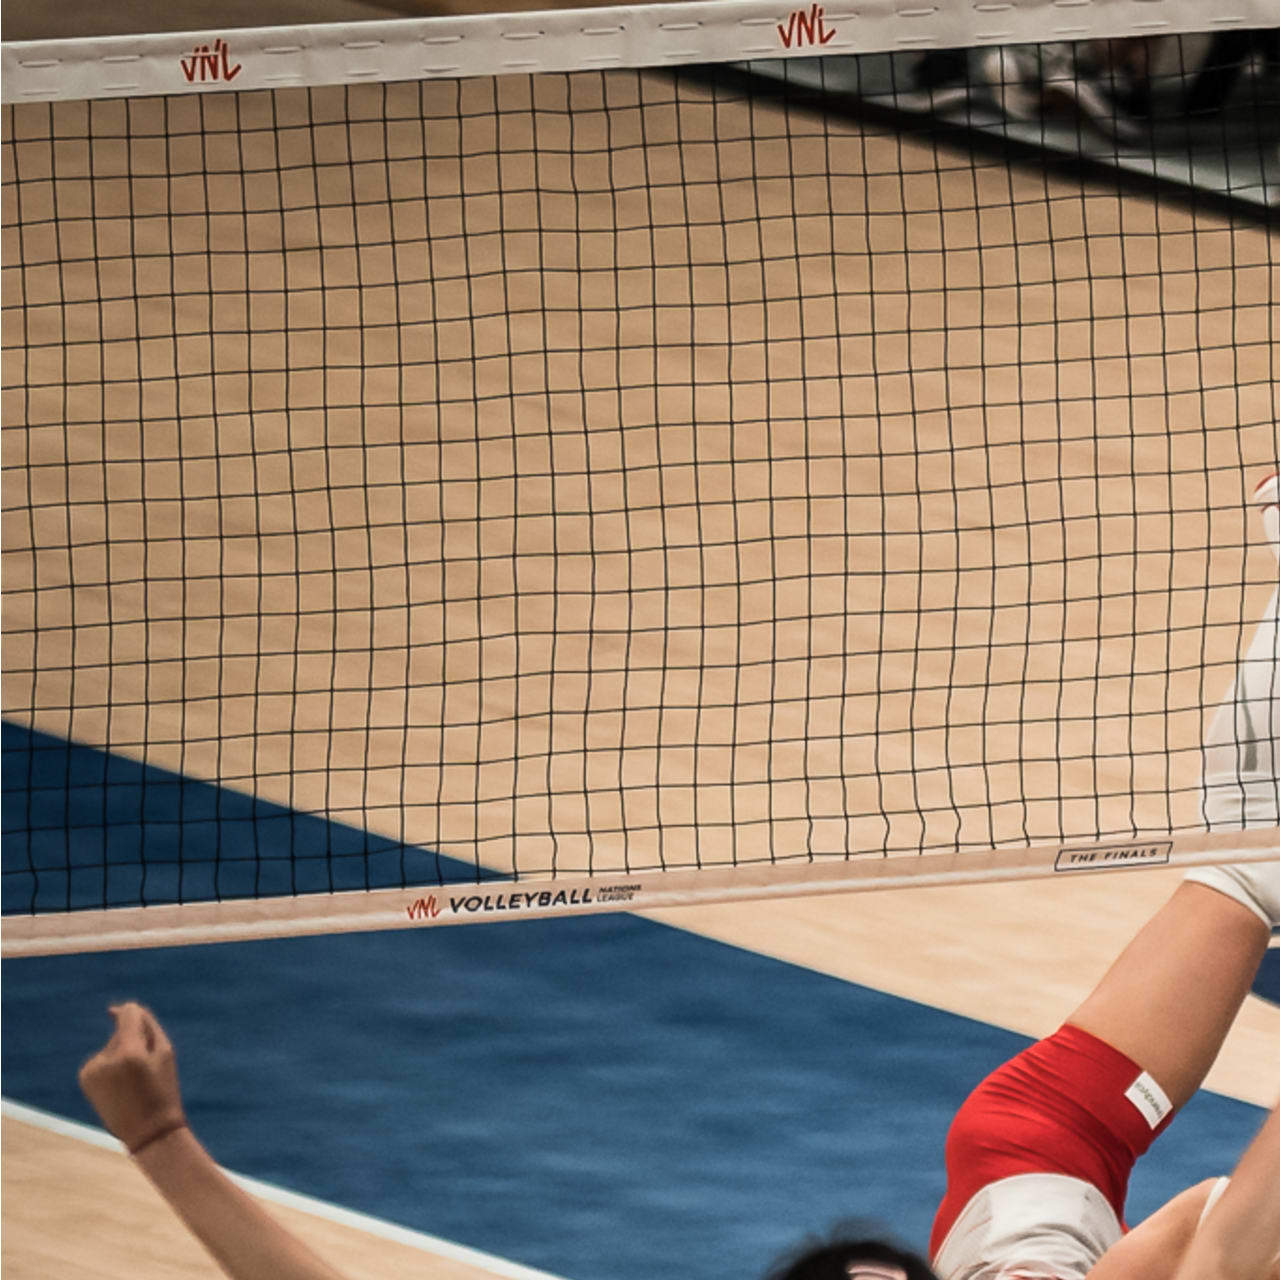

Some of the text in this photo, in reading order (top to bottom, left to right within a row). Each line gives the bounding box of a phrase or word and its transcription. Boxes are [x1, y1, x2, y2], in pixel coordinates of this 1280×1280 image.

[778, 4, 836, 48] VNL
[181, 38, 242, 82] VNL
[1070, 848, 1158, 863] THE FINALS
[406, 888, 593, 921] VNL VOLLEYBALL
